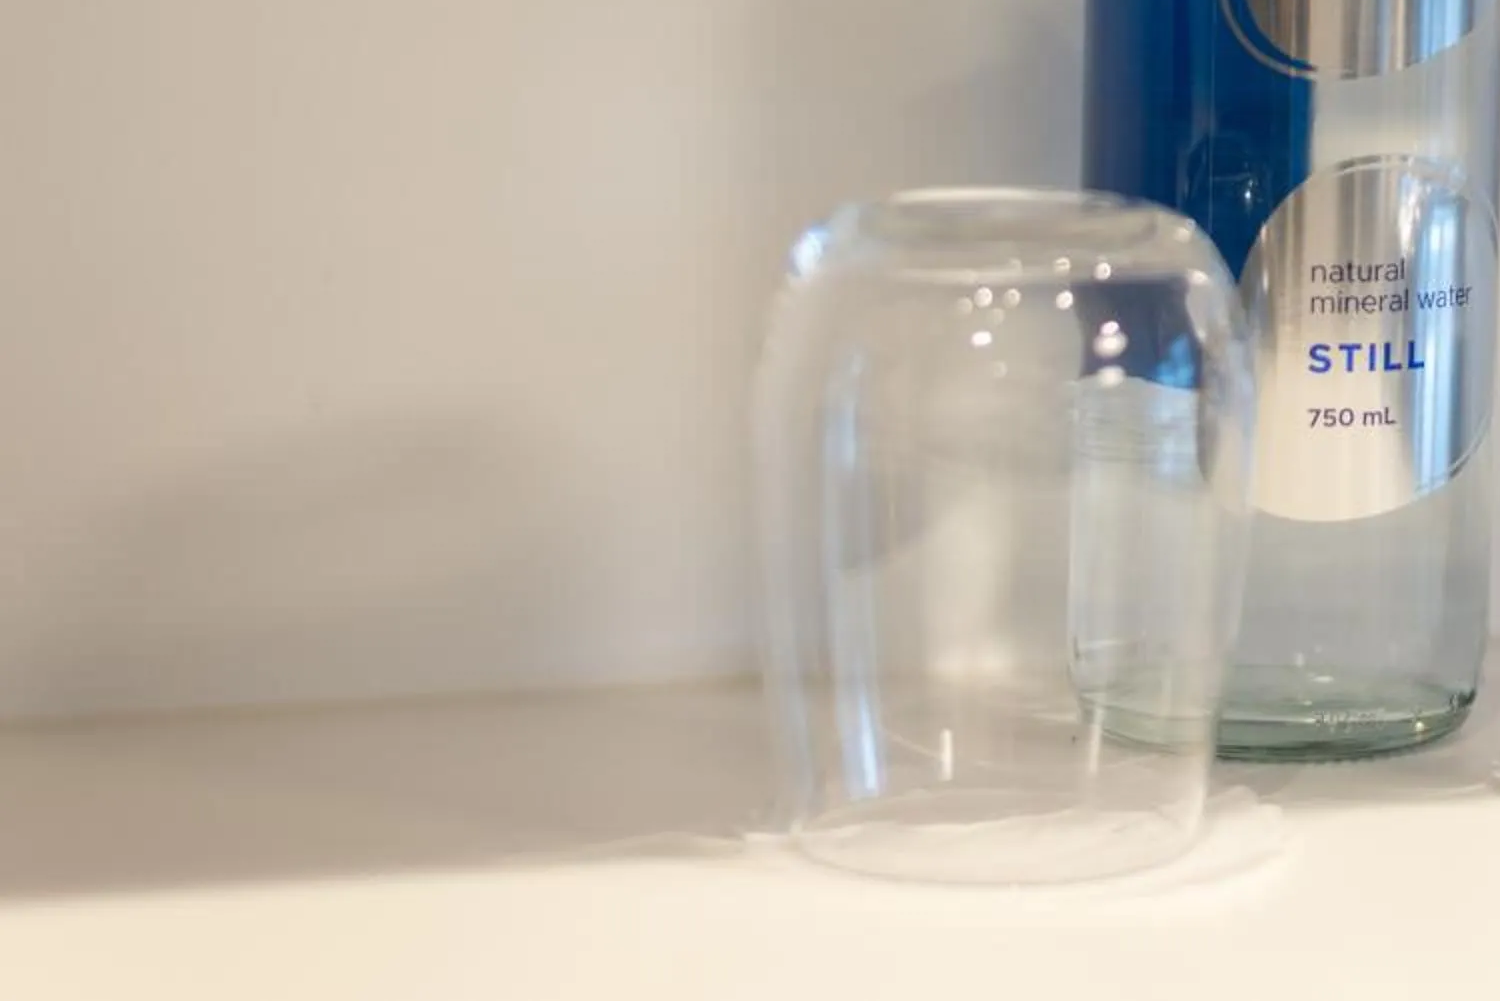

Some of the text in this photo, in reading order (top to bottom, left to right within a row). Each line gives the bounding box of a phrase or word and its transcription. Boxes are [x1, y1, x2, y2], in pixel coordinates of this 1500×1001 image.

[1311, 258, 1406, 283] natural
[1311, 285, 1473, 314] mineral water
[1309, 340, 1425, 373] STILL
[1308, 407, 1396, 428] 750 mL
